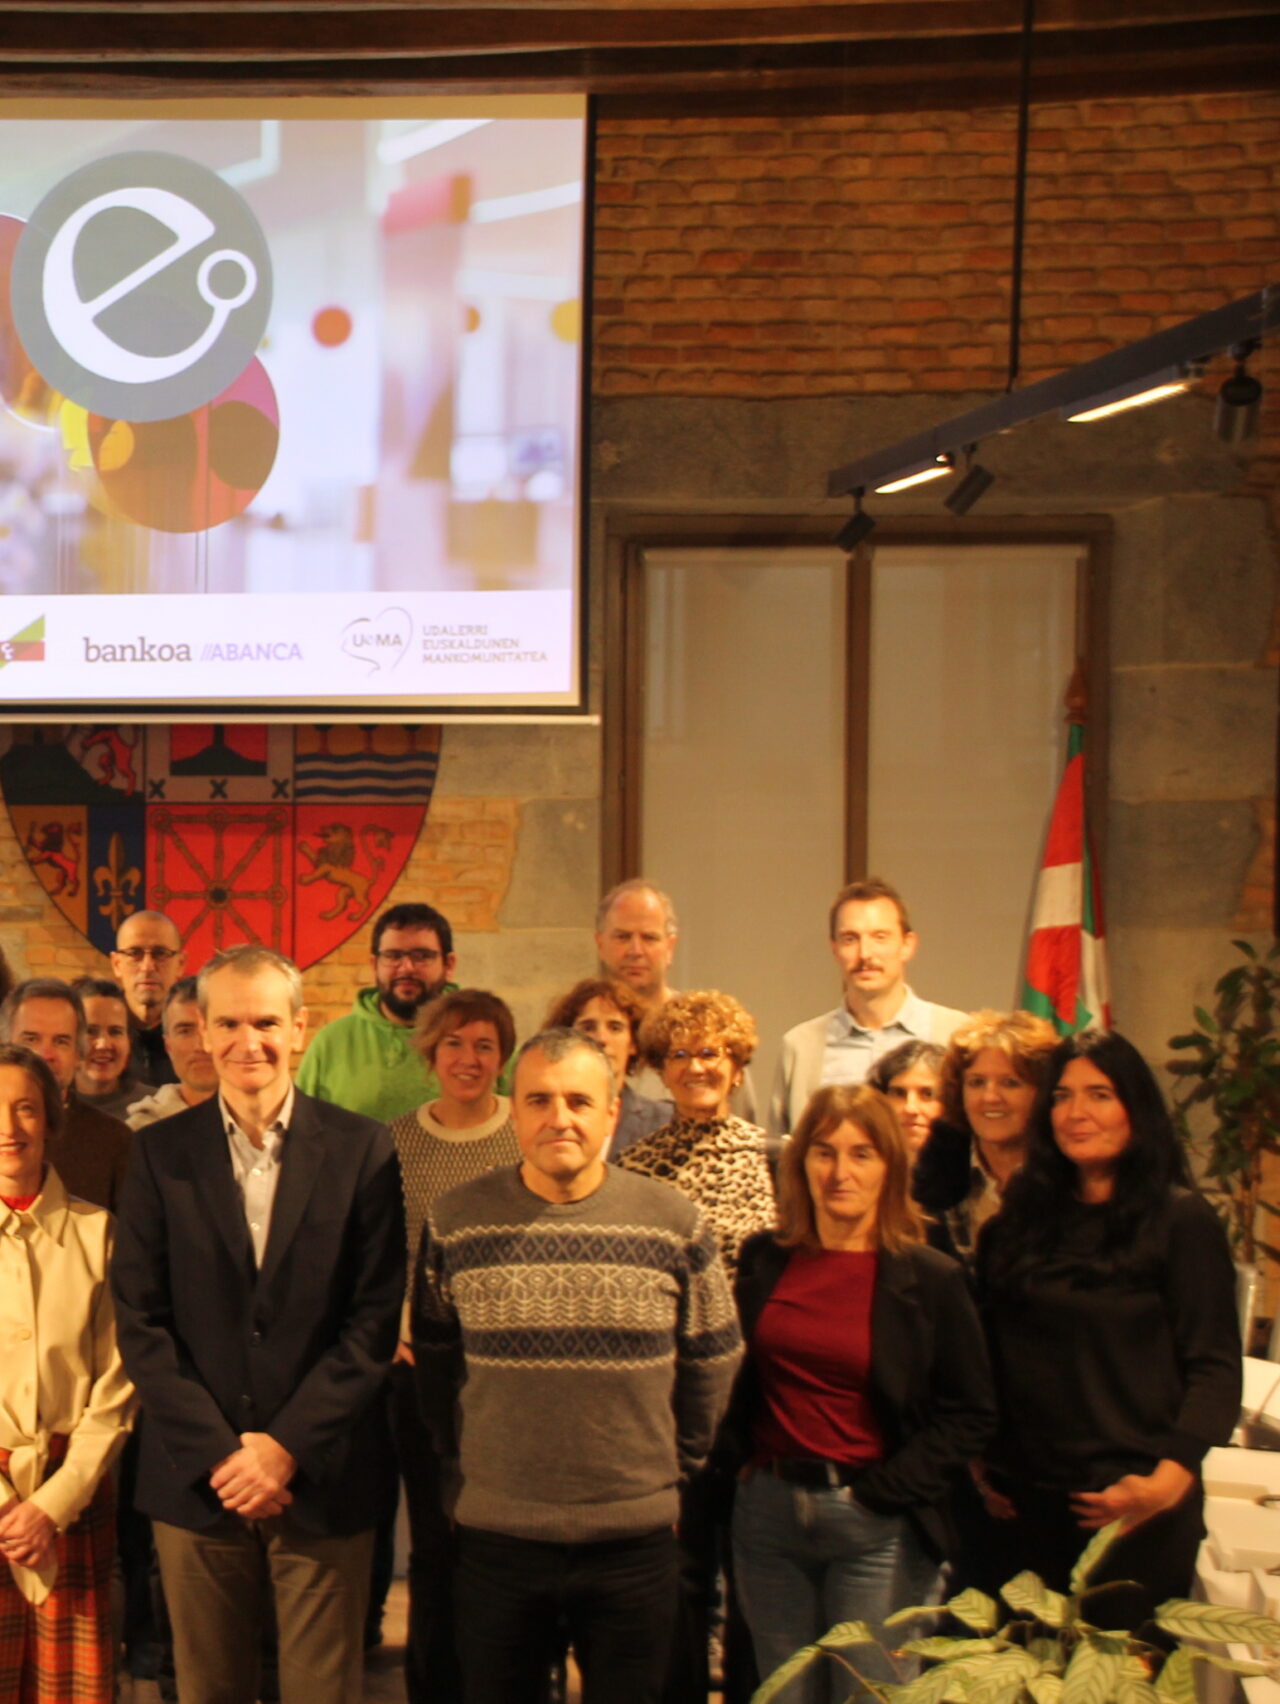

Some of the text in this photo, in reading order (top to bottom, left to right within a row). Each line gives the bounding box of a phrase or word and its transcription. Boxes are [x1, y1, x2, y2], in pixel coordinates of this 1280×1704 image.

[422, 625, 489, 637] UDALERRI
[83, 637, 192, 663] bankoa
[422, 638, 521, 650] EUSKALDUNEN
[422, 651, 549, 664] MANKOMUNITATEA
